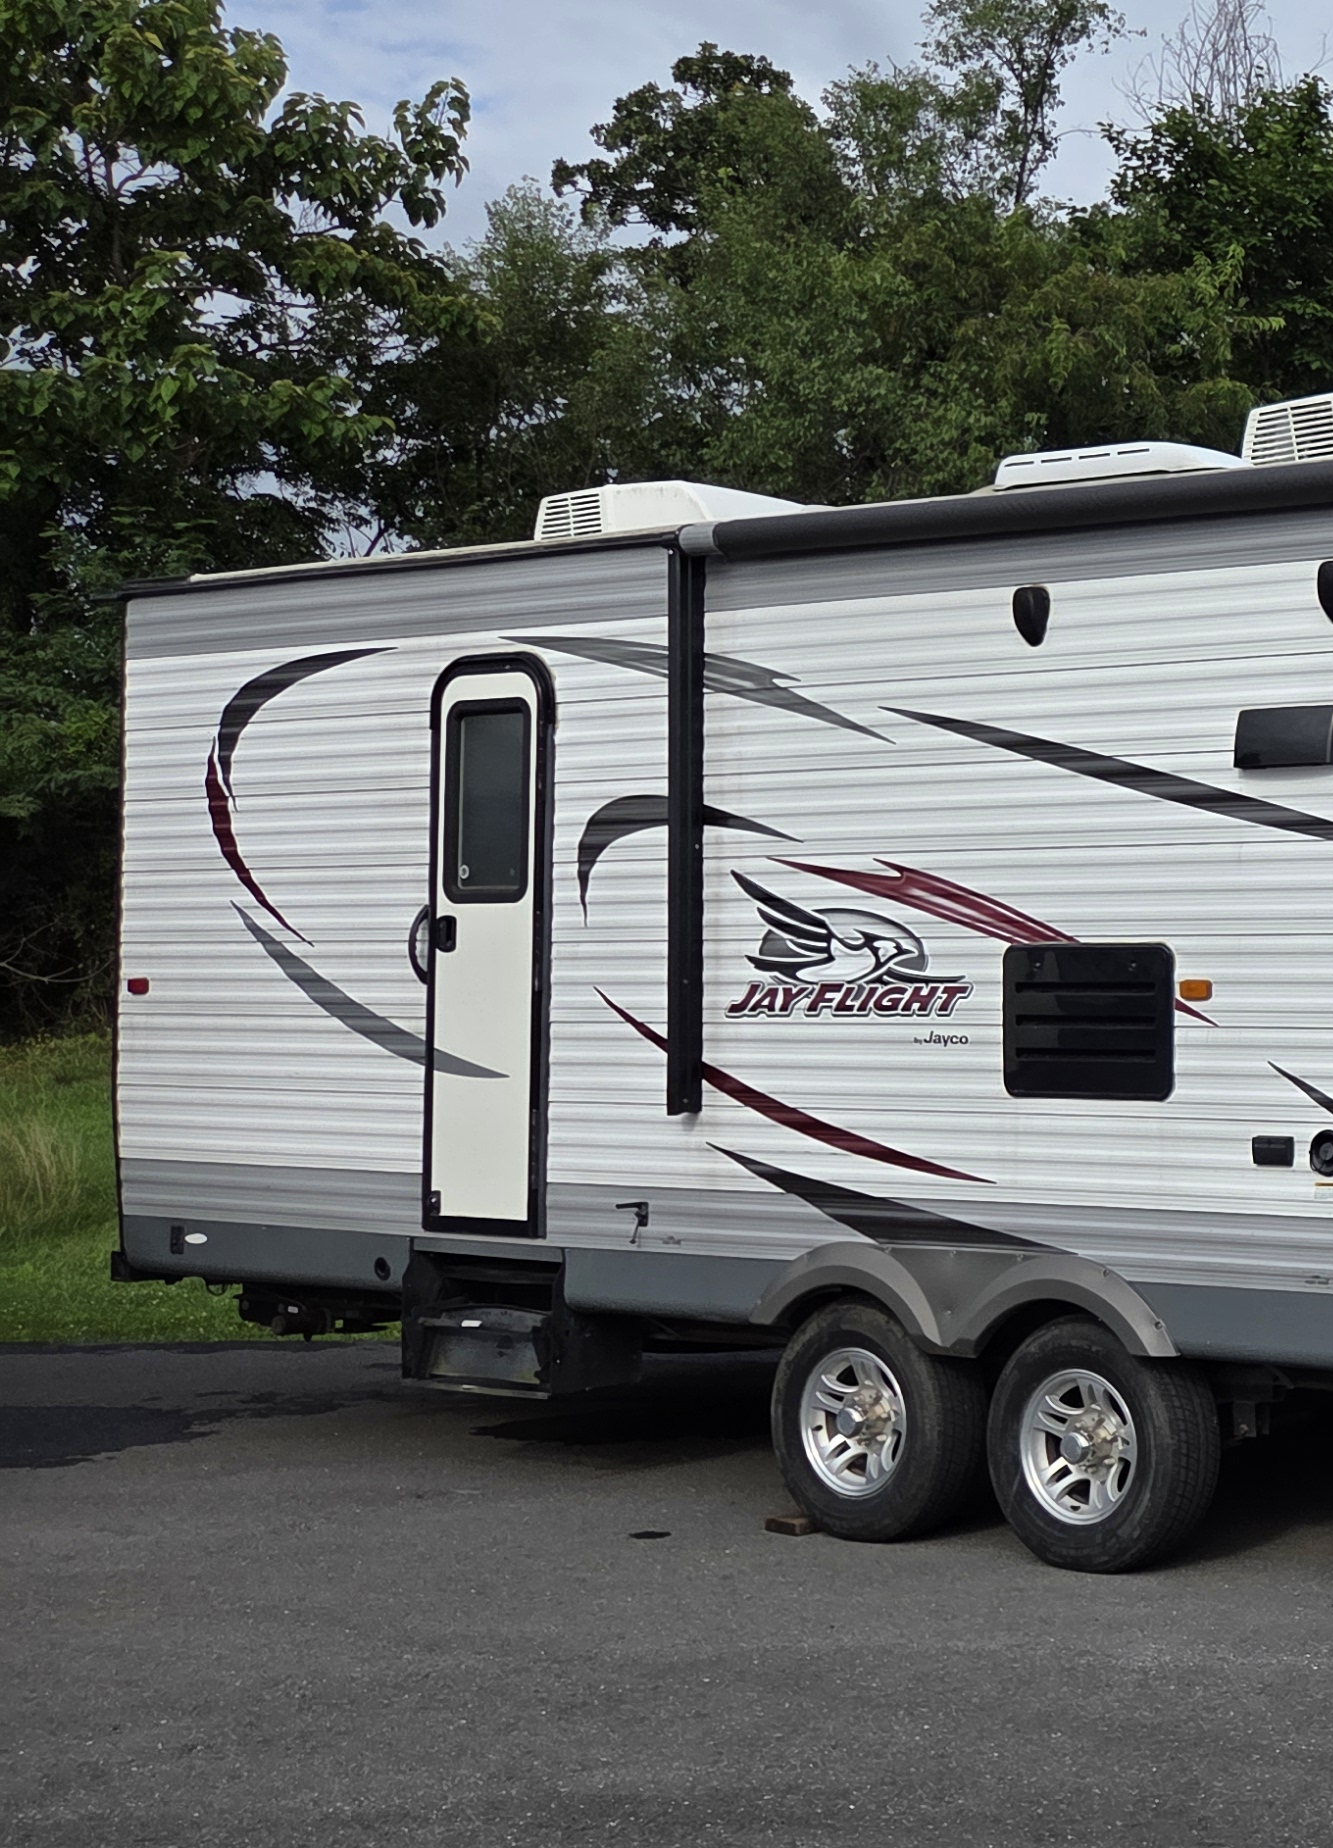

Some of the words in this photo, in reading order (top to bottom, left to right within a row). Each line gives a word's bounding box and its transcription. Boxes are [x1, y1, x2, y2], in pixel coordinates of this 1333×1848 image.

[726, 980, 808, 1015] JAY
[805, 980, 972, 1016] FLIGHT
[923, 1030, 969, 1047] Jayco
